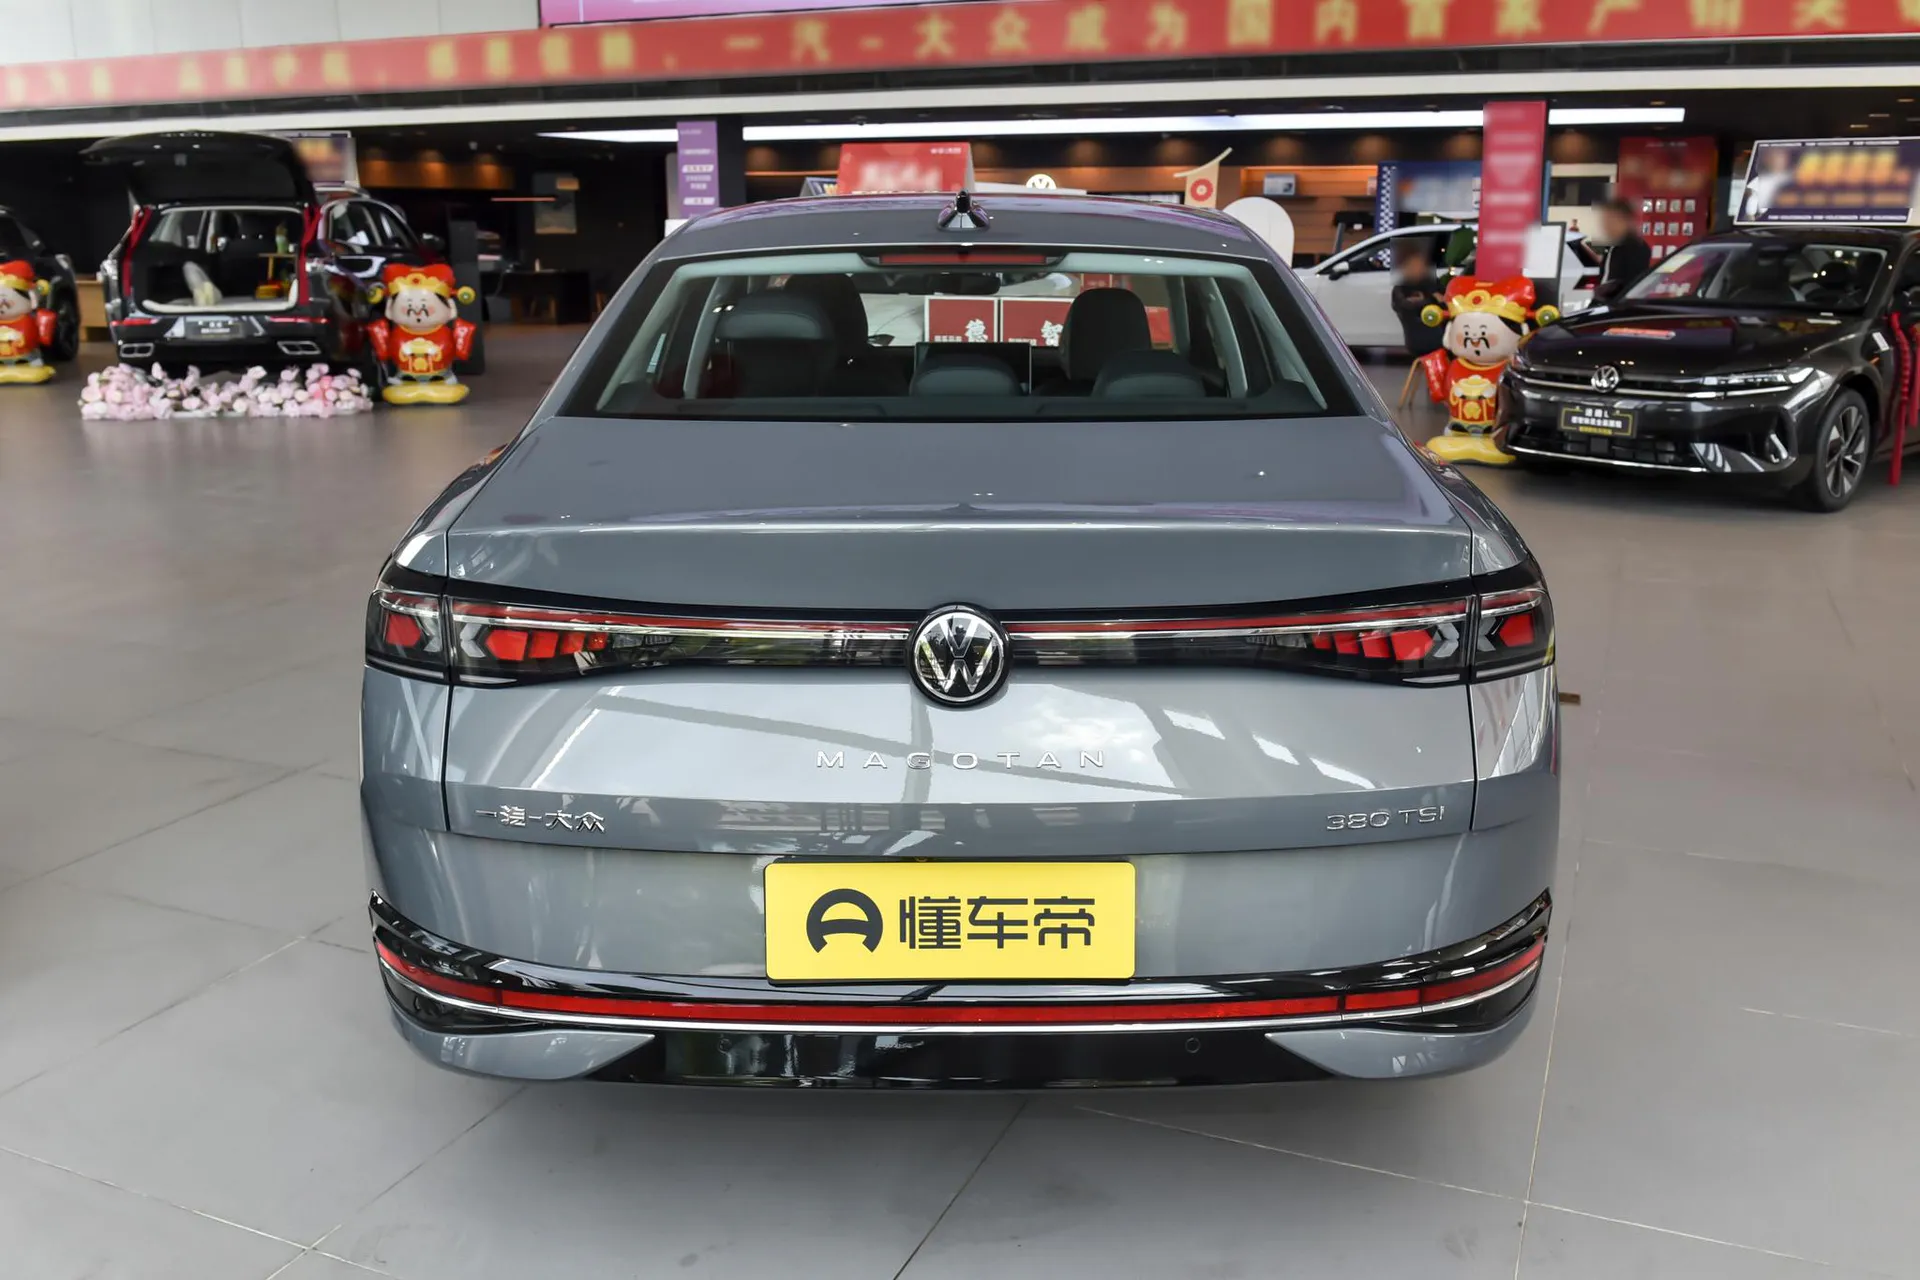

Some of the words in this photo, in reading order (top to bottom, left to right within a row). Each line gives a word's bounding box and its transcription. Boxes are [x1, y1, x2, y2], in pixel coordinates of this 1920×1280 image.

[816, 750, 1104, 769] MAGOTAN
[1326, 811, 1390, 831] 380
[1398, 805, 1445, 825] TSI
[899, 896, 1096, 949] 懂车帝
